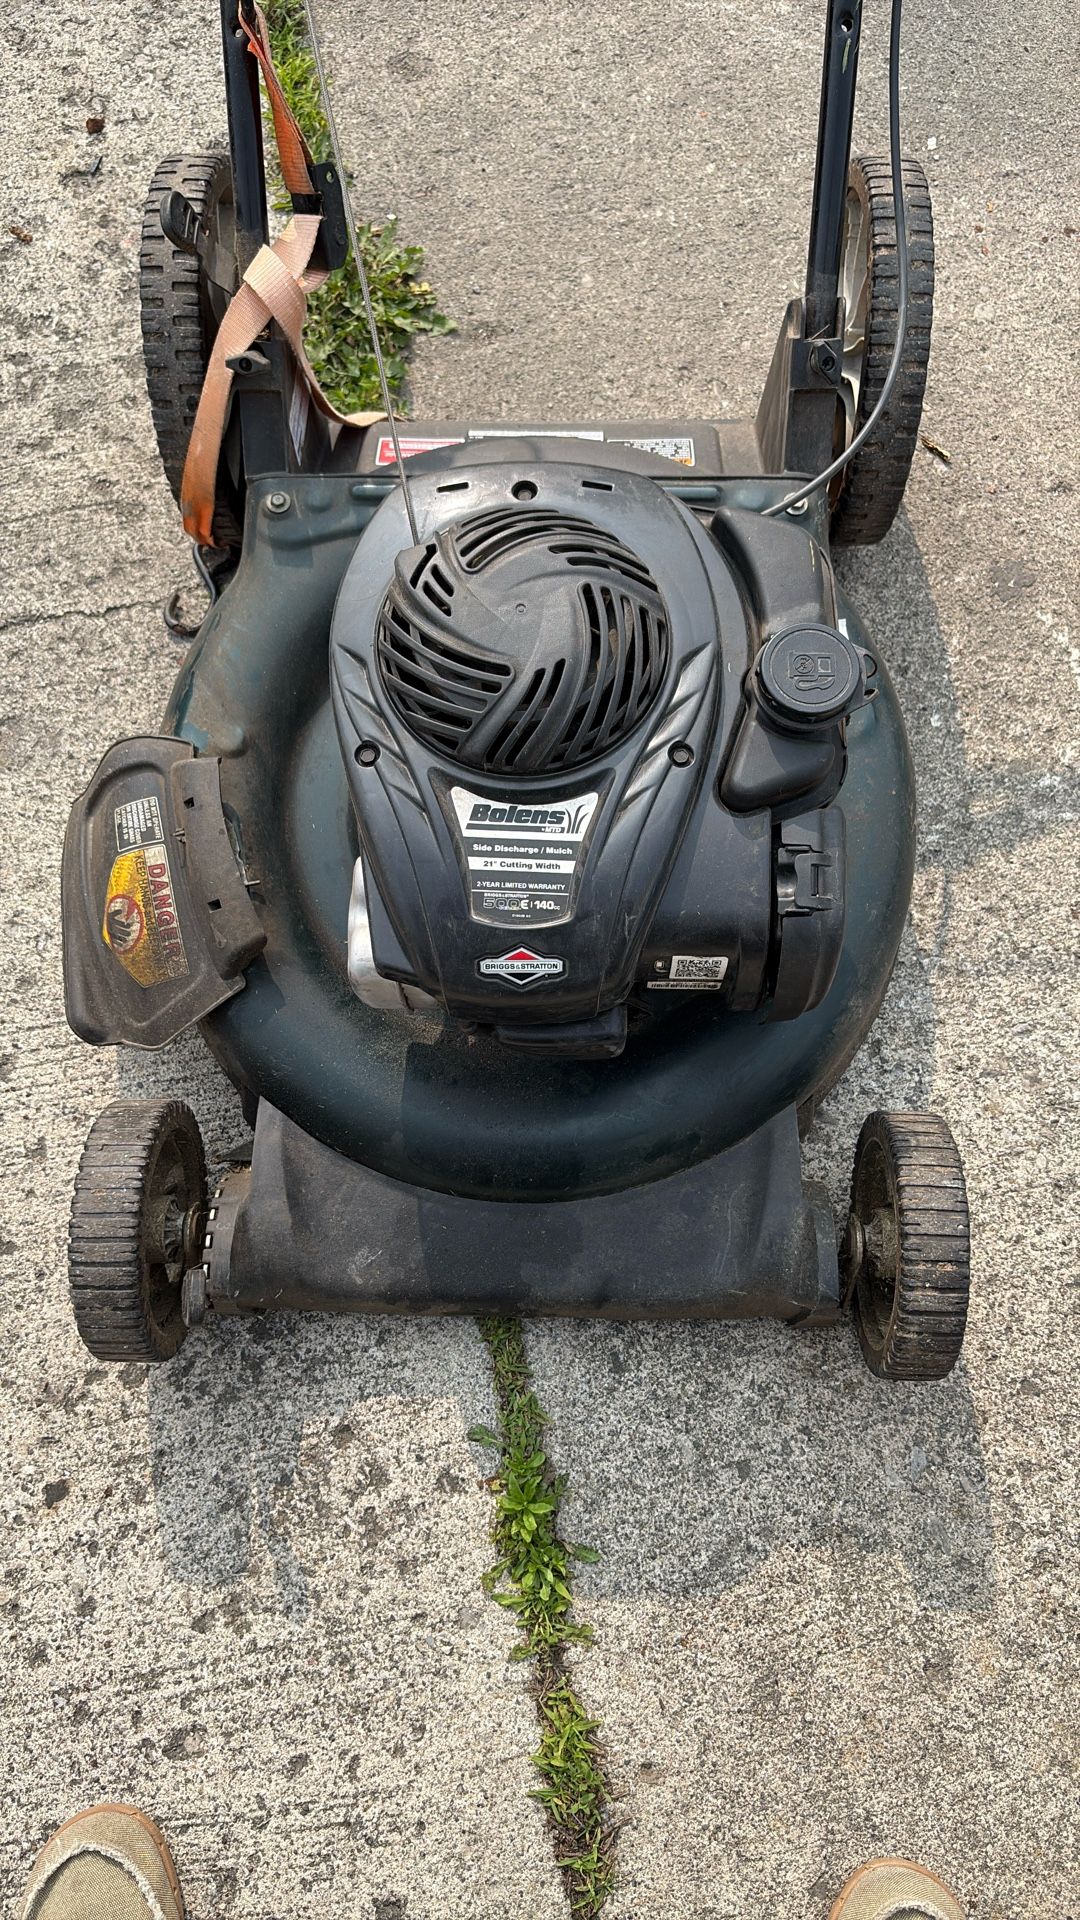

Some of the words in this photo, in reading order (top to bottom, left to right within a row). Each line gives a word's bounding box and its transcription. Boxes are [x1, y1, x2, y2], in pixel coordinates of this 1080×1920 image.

[469, 804, 566, 825] Bolens
[152, 817, 161, 839] OPERATE
[473, 843, 492, 852] Side
[494, 844, 539, 854] Discharge
[540, 846, 545, 854] /
[546, 847, 573, 855] Mulch
[135, 855, 147, 876] KEEP
[483, 860, 497, 868] 21"
[500, 861, 533, 870] Cutting
[535, 862, 561, 870] Width
[139, 880, 152, 909] HANDS
[528, 882, 565, 890] WARRANTY
[145, 911, 153, 925] and
[148, 863, 181, 959] DANGER
